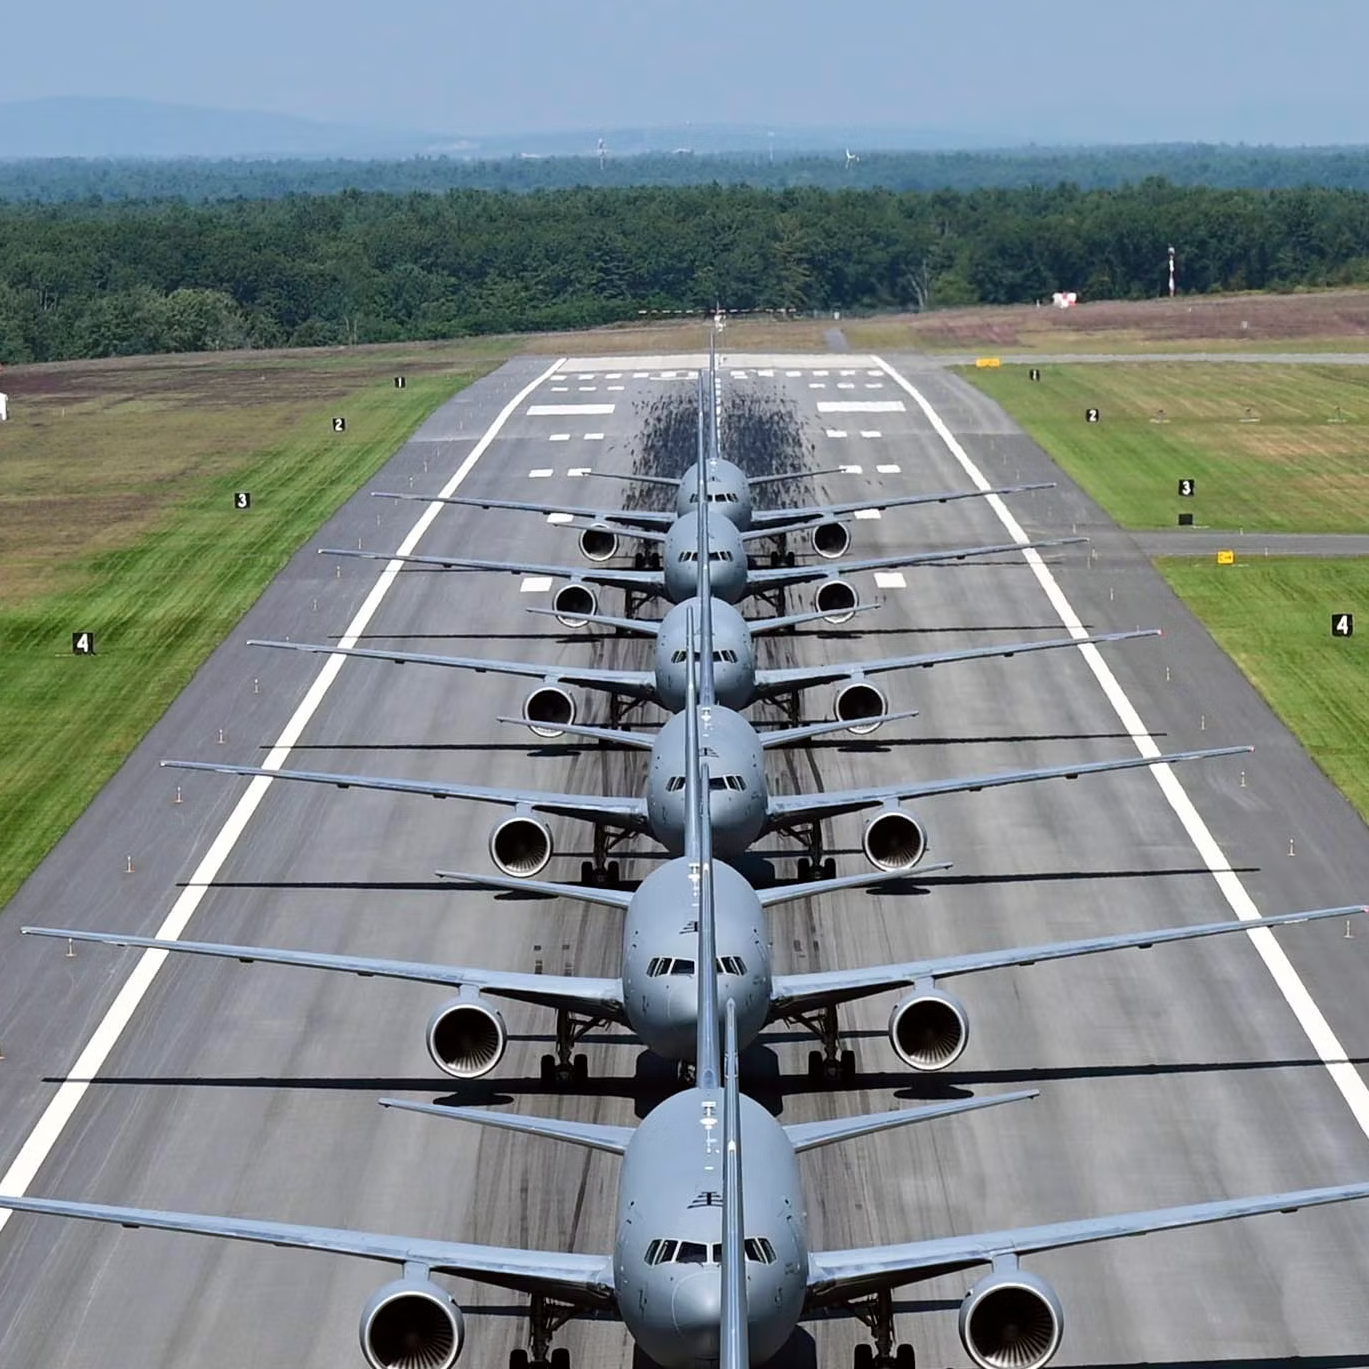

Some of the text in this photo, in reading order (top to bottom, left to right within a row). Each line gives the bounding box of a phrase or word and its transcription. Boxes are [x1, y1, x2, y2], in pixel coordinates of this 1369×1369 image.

[1089, 409, 1097, 422] 2
[335, 418, 343, 431] 2
[1183, 481, 1191, 495] 3
[238, 493, 247, 507] 3
[1337, 615, 1348, 635] 4
[77, 633, 88, 653] 4
